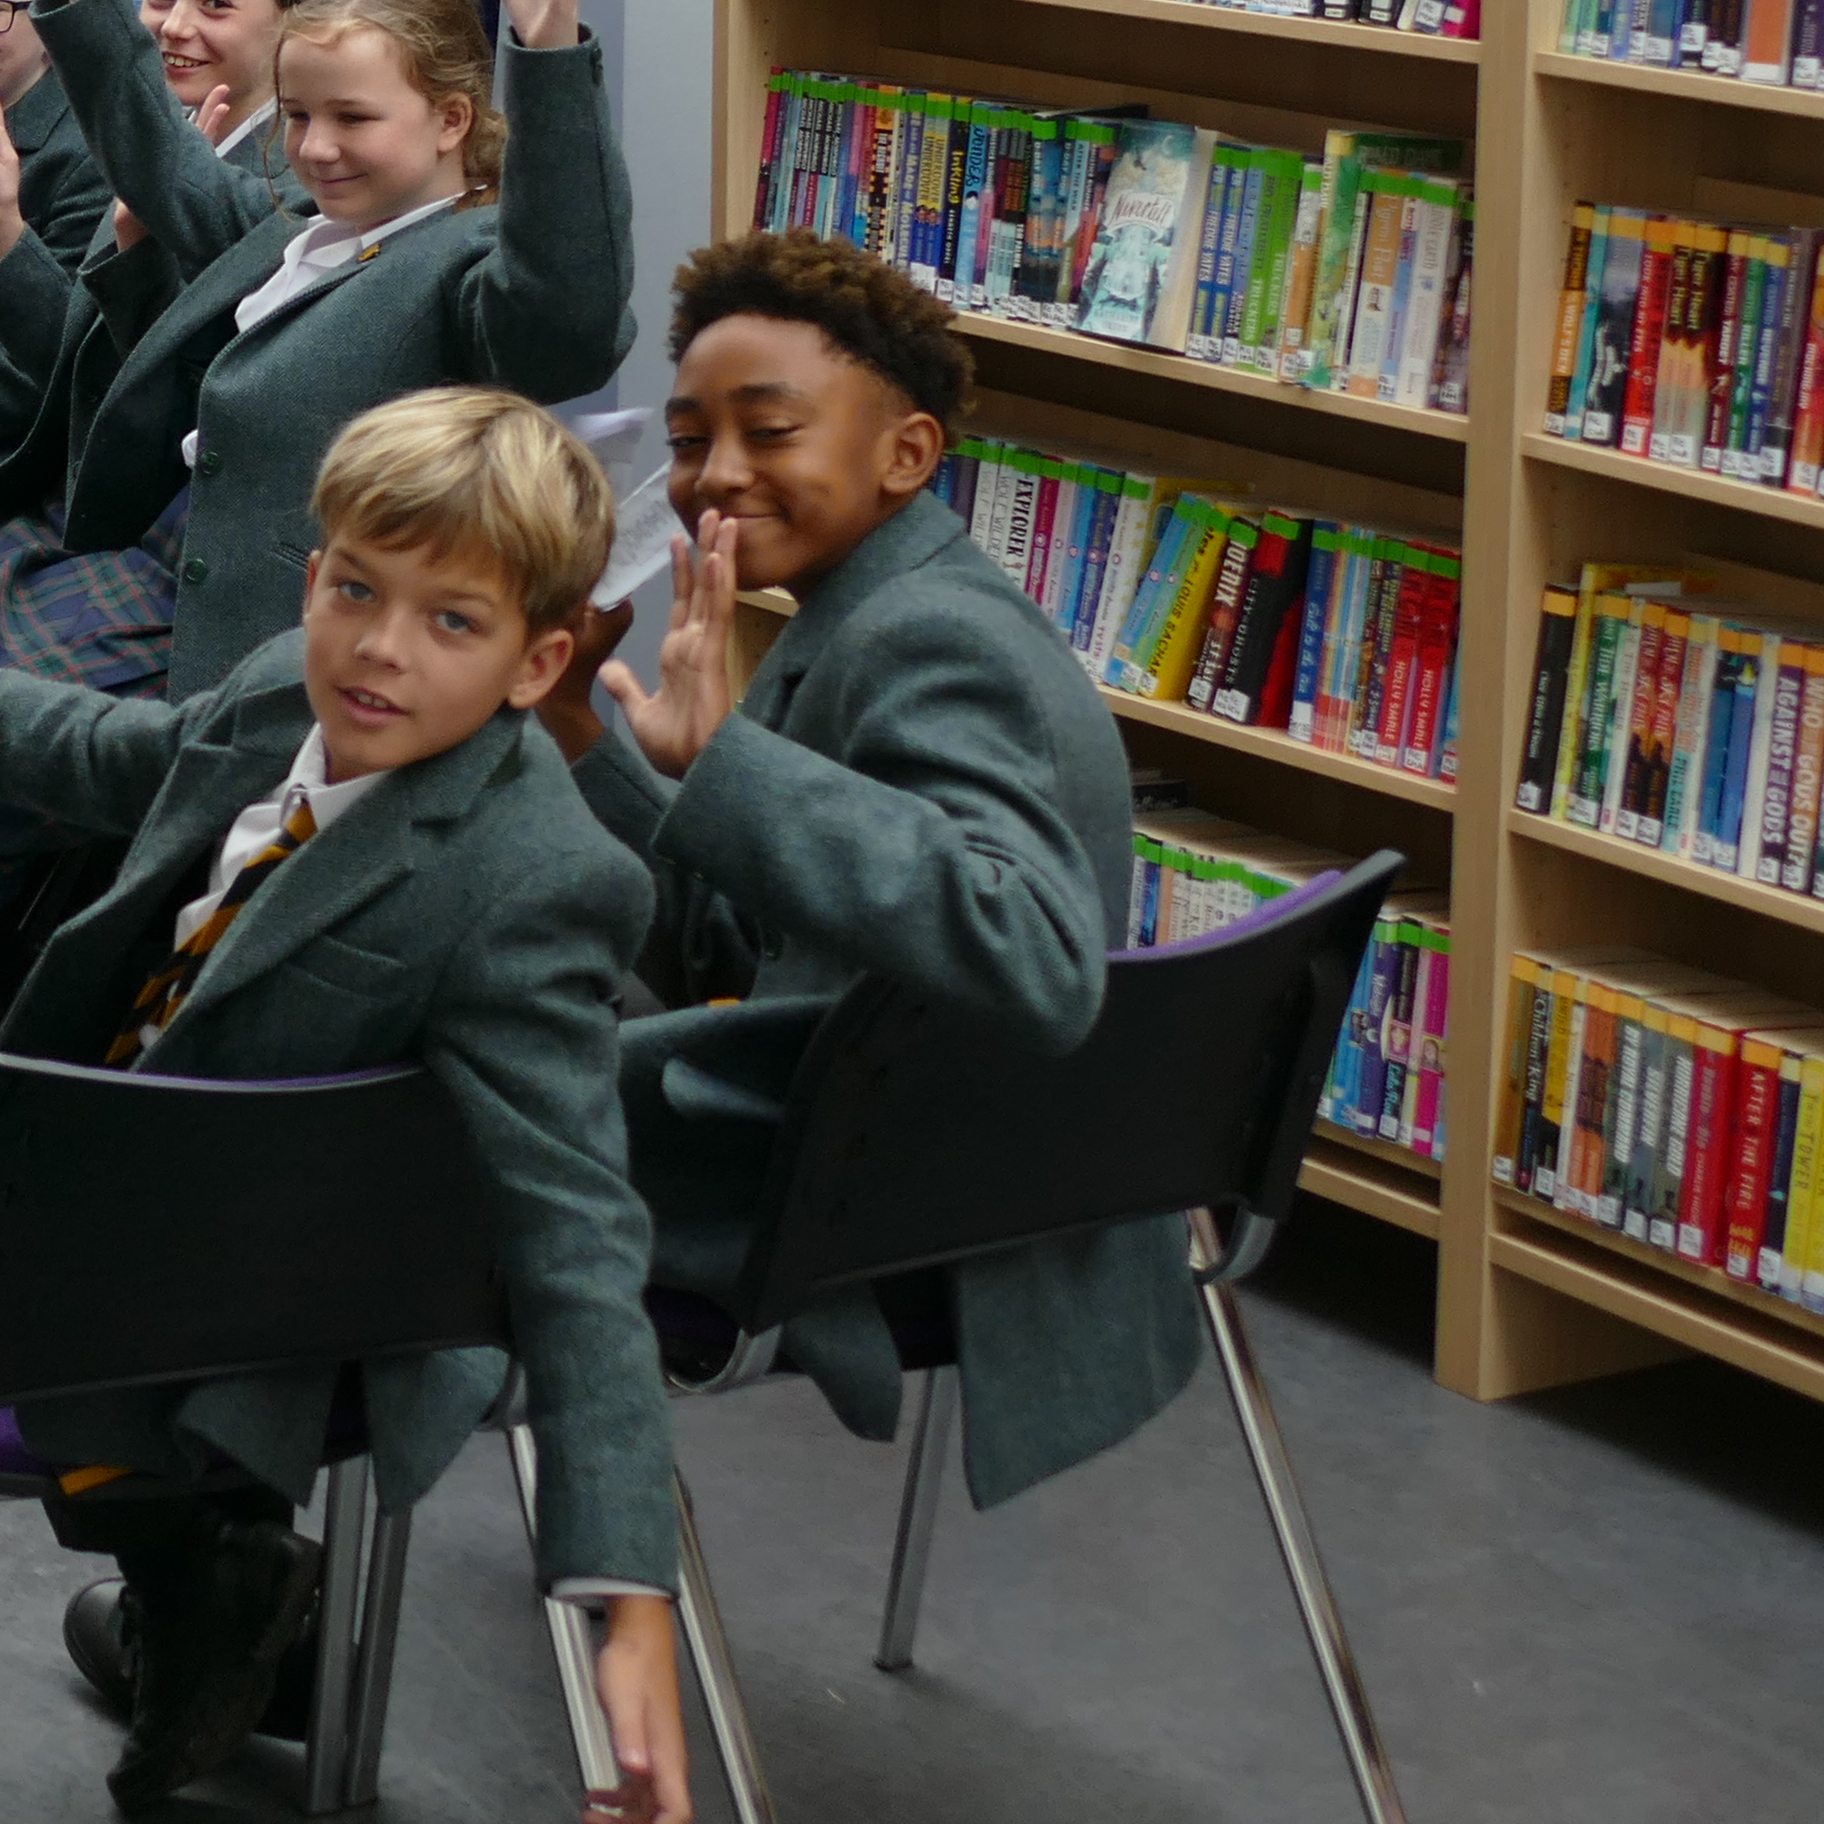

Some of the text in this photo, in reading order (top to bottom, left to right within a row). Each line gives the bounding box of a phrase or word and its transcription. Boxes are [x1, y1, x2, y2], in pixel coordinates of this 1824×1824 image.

[903, 155, 918, 190] MADE
[918, 135, 934, 201] UNDERCOVER
[930, 138, 946, 204] UNDERCOVER
[1012, 239, 1023, 268] PALMER
[1200, 210, 1219, 282] FREDDIE YATES
[1217, 213, 1237, 286] FREDDIE YATES
[1641, 254, 1655, 281] LOOK
[1245, 278, 1263, 341] TRUCKERS
[1267, 252, 1284, 316] TRUCKERS
[1671, 248, 1691, 325] Tiger Heart
[1687, 252, 1710, 330] Tiger Heart
[1557, 305, 1576, 374] WOLF'S DEN
[1718, 320, 1733, 365] TARGET
[1738, 324, 1752, 366] KILLER
[1756, 328, 1774, 386] REVENGE
[1008, 479, 1034, 558] EXPLORER
[1147, 578, 1195, 676] LOUIS SACHAR
[1242, 578, 1258, 616] CITY
[1385, 661, 1406, 740] HOLLY SMALE
[1413, 669, 1433, 749] HOLLY SMALE
[1588, 681, 1609, 751] WARRIORS
[1761, 677, 1798, 845] AGAINST GODS
[1795, 754, 1816, 809] GODS
[1525, 998, 1545, 1101] Children King
[1615, 1025, 1640, 1164] BY ROYAL COMMAND
[1667, 1056, 1693, 1178] HURRICANE GOLD
[1736, 1072, 1765, 1210] AFTER THE FIRE
[1796, 1132, 1815, 1190] TOWER
